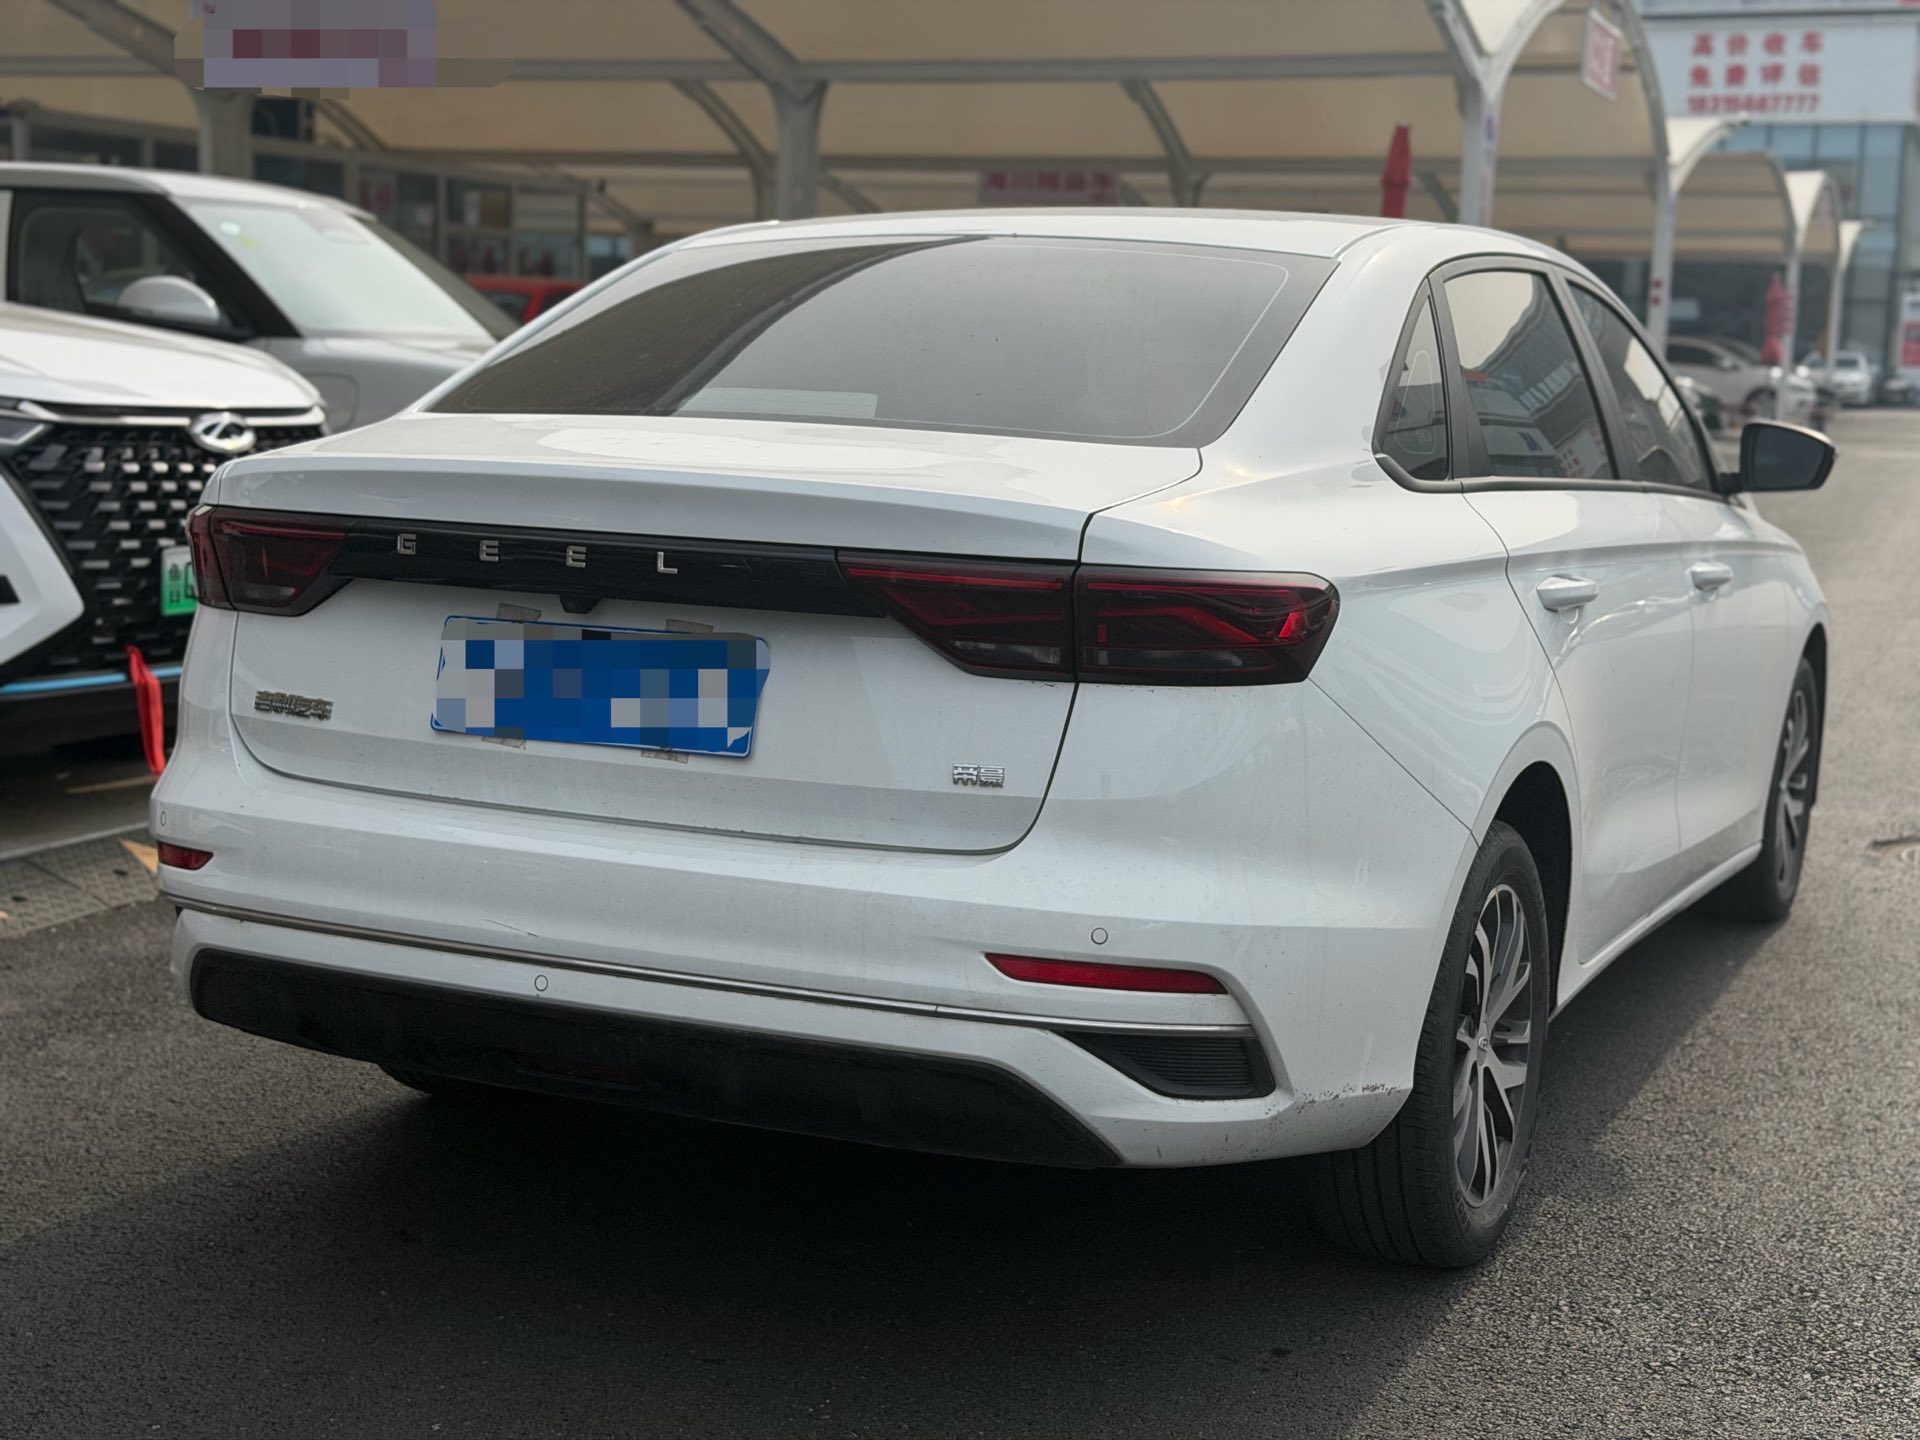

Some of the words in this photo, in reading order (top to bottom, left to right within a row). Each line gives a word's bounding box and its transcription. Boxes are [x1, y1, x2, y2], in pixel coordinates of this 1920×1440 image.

[1689, 63, 1822, 88] 免费评估
[952, 763, 1005, 788] 帝豪
